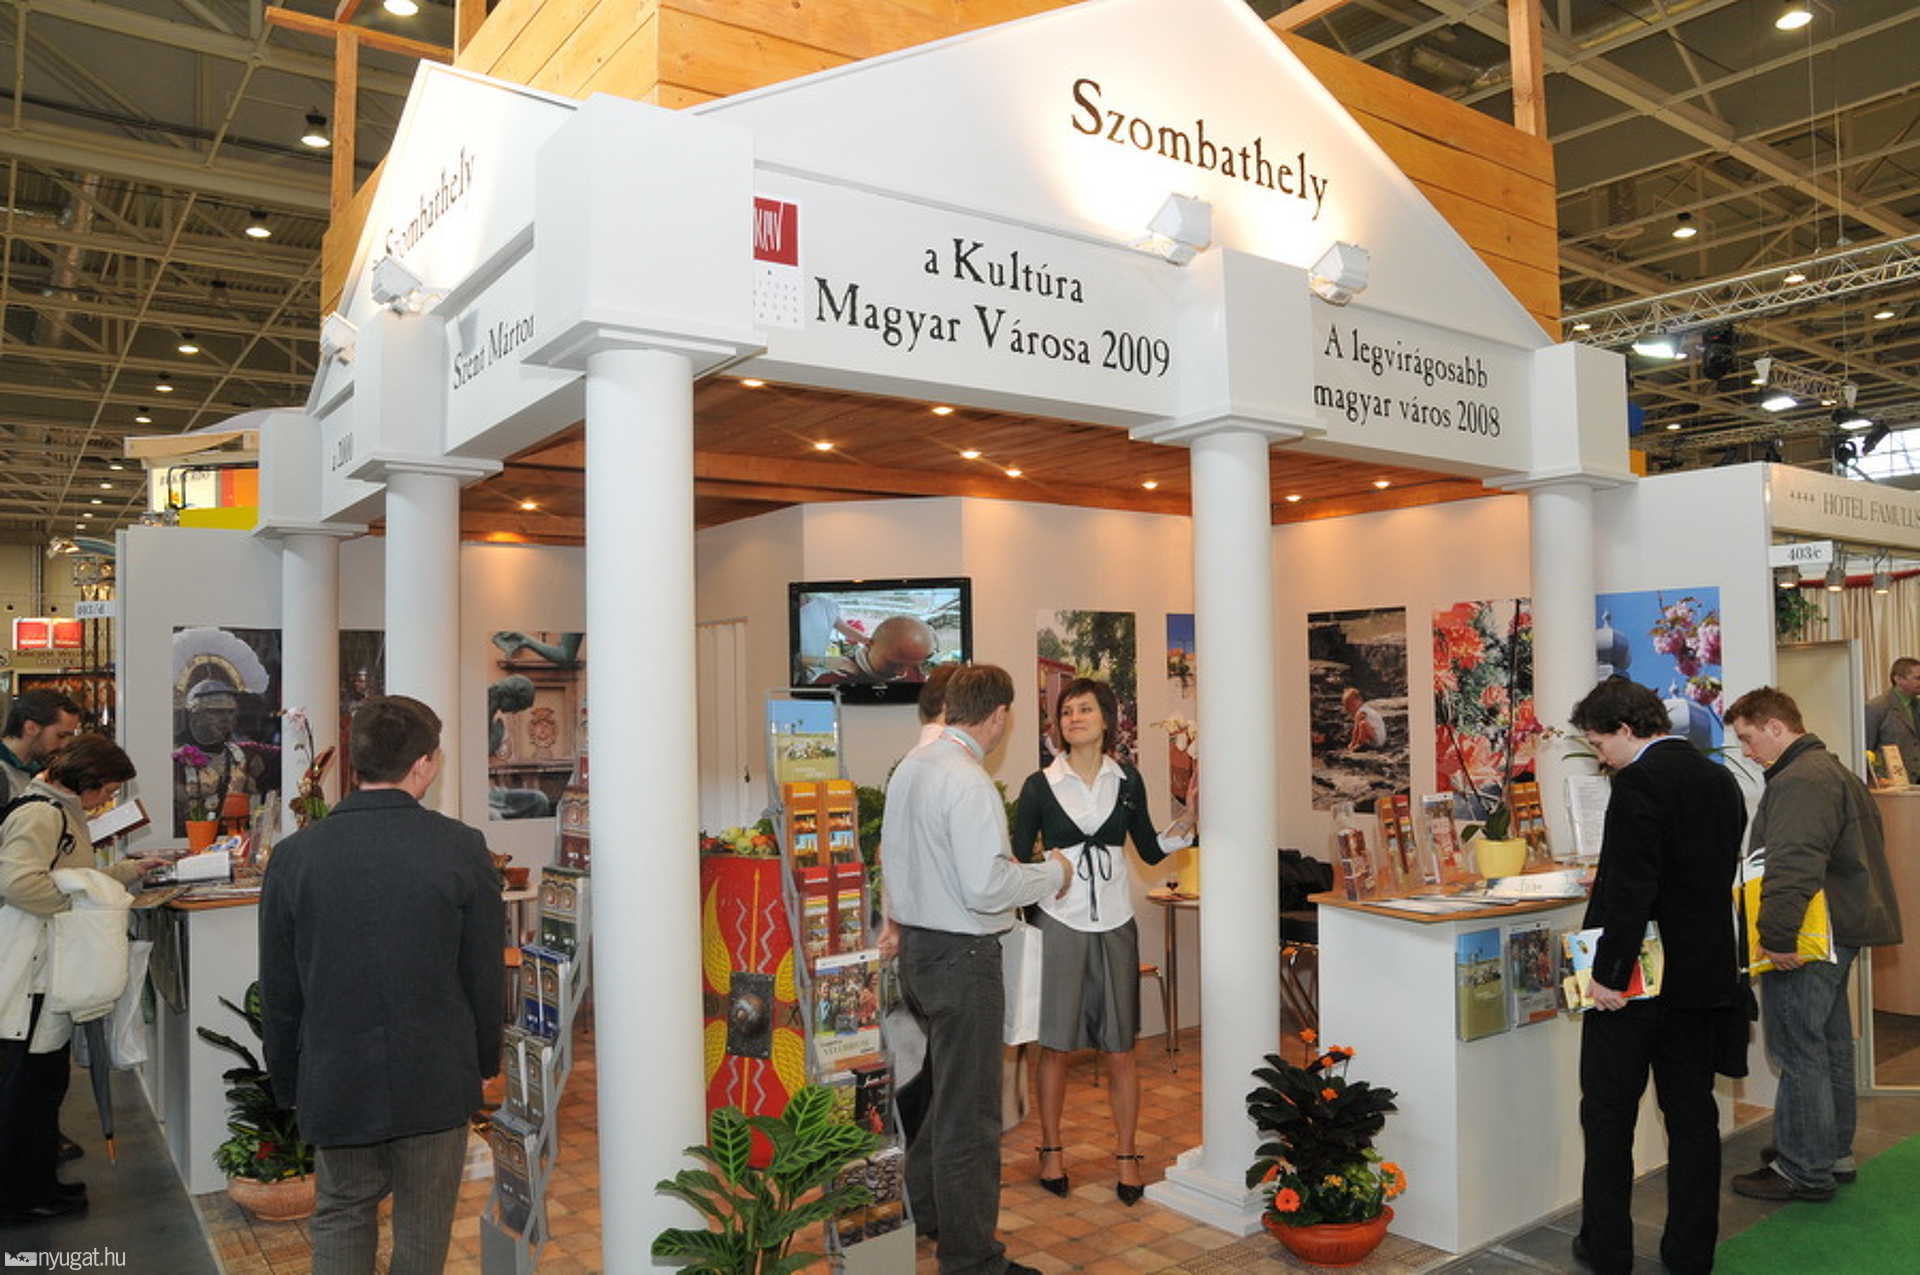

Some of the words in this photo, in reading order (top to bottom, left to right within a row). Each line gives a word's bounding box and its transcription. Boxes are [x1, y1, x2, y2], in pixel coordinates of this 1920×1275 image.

[1070, 77, 1329, 222] Szombathely
[924, 248, 940, 275] a
[953, 237, 1085, 304] Kultúra
[814, 276, 961, 352] Magyar
[974, 304, 1092, 365] Városa
[1101, 329, 1171, 378] 2009
[1323, 322, 1344, 360] A
[1351, 327, 1488, 389] legvirágosabb
[1313, 383, 1392, 427] magyar
[1399, 395, 1452, 428] város
[1456, 399, 1501, 438] 2008
[1822, 491, 1868, 521] HOTEL
